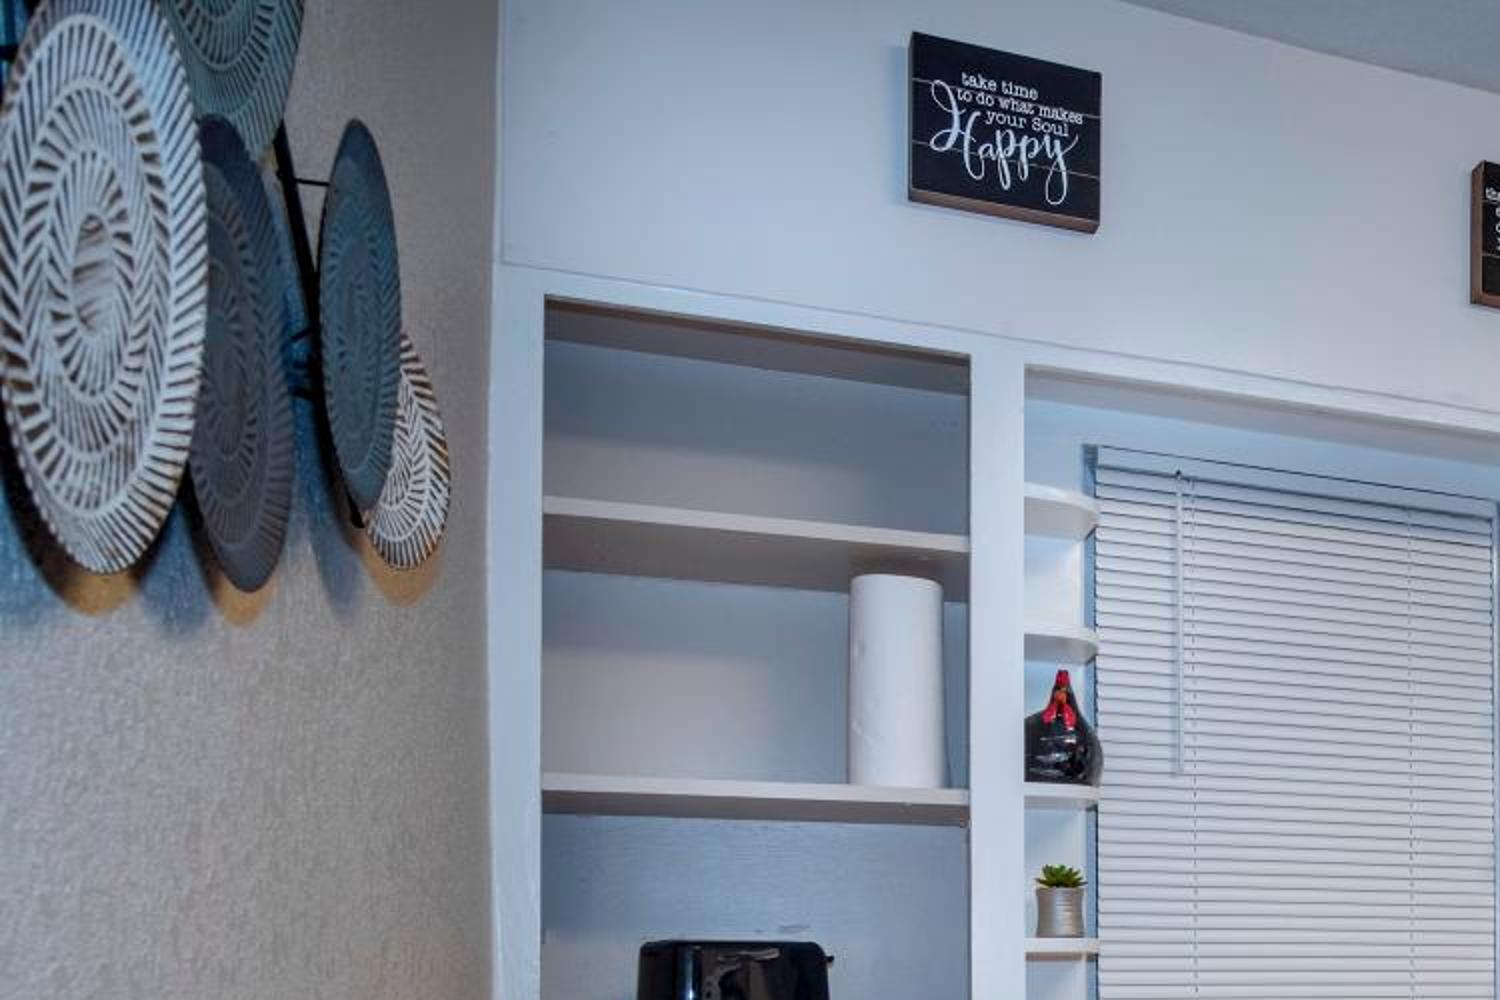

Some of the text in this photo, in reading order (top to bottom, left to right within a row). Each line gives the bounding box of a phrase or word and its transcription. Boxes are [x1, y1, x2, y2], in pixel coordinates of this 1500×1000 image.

[961, 72, 1039, 101] take time
[957, 88, 1083, 125] to do what makes
[985, 109, 1027, 129] your
[930, 80, 1079, 205] Happy
